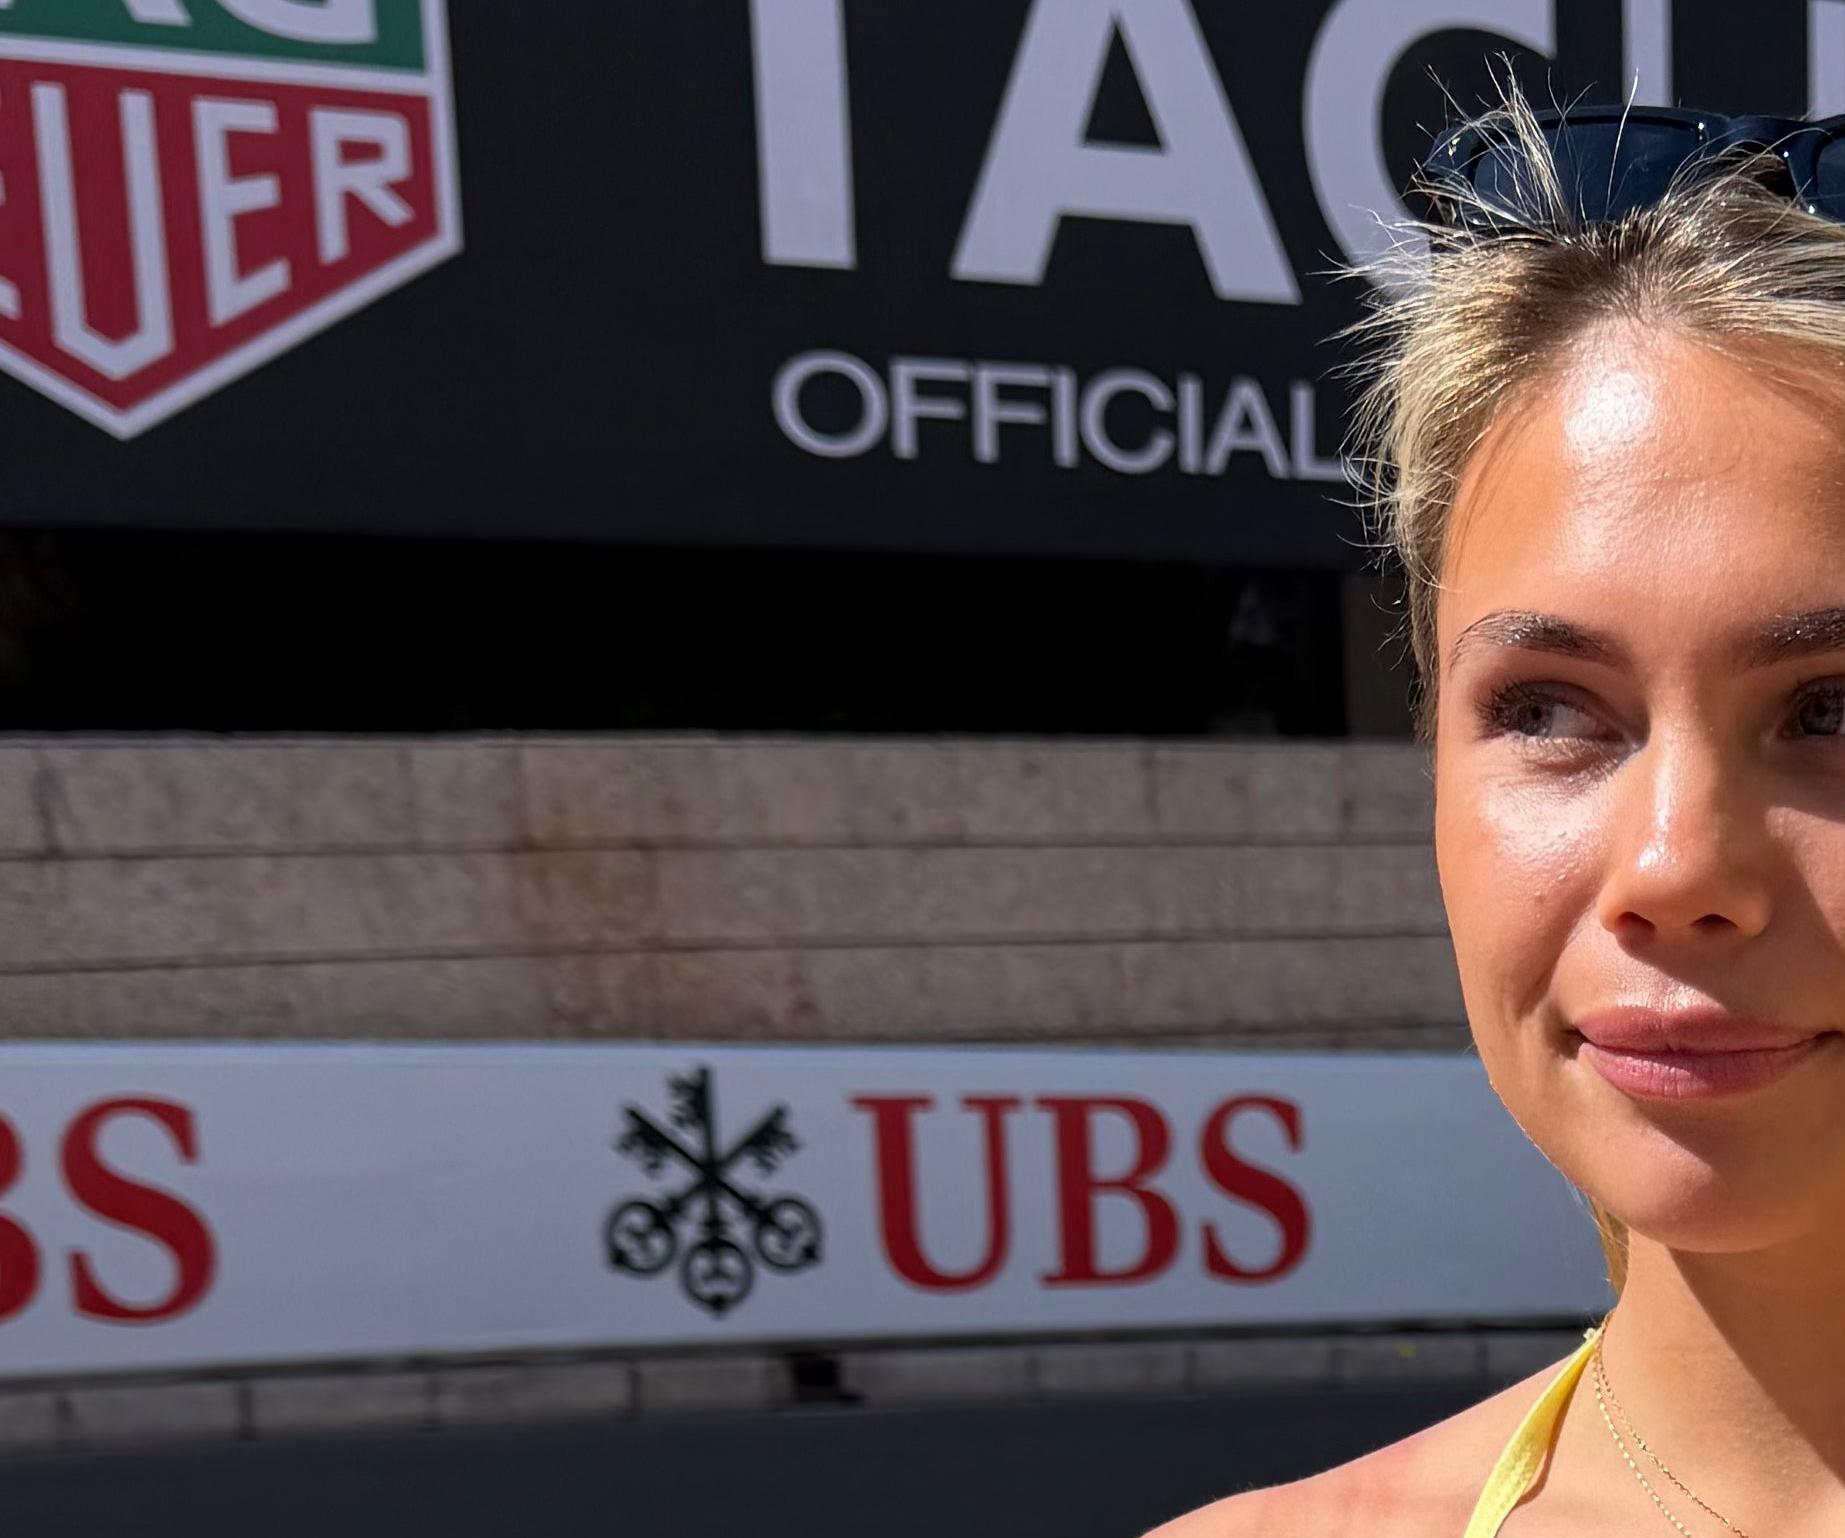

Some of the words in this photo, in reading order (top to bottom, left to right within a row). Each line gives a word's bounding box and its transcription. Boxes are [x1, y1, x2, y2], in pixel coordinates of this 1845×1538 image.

[0, 81, 415, 381] UER
[772, 349, 1350, 482] OFFICIAL
[0, 1094, 219, 1327] S
[850, 1094, 1313, 1295] UBS
